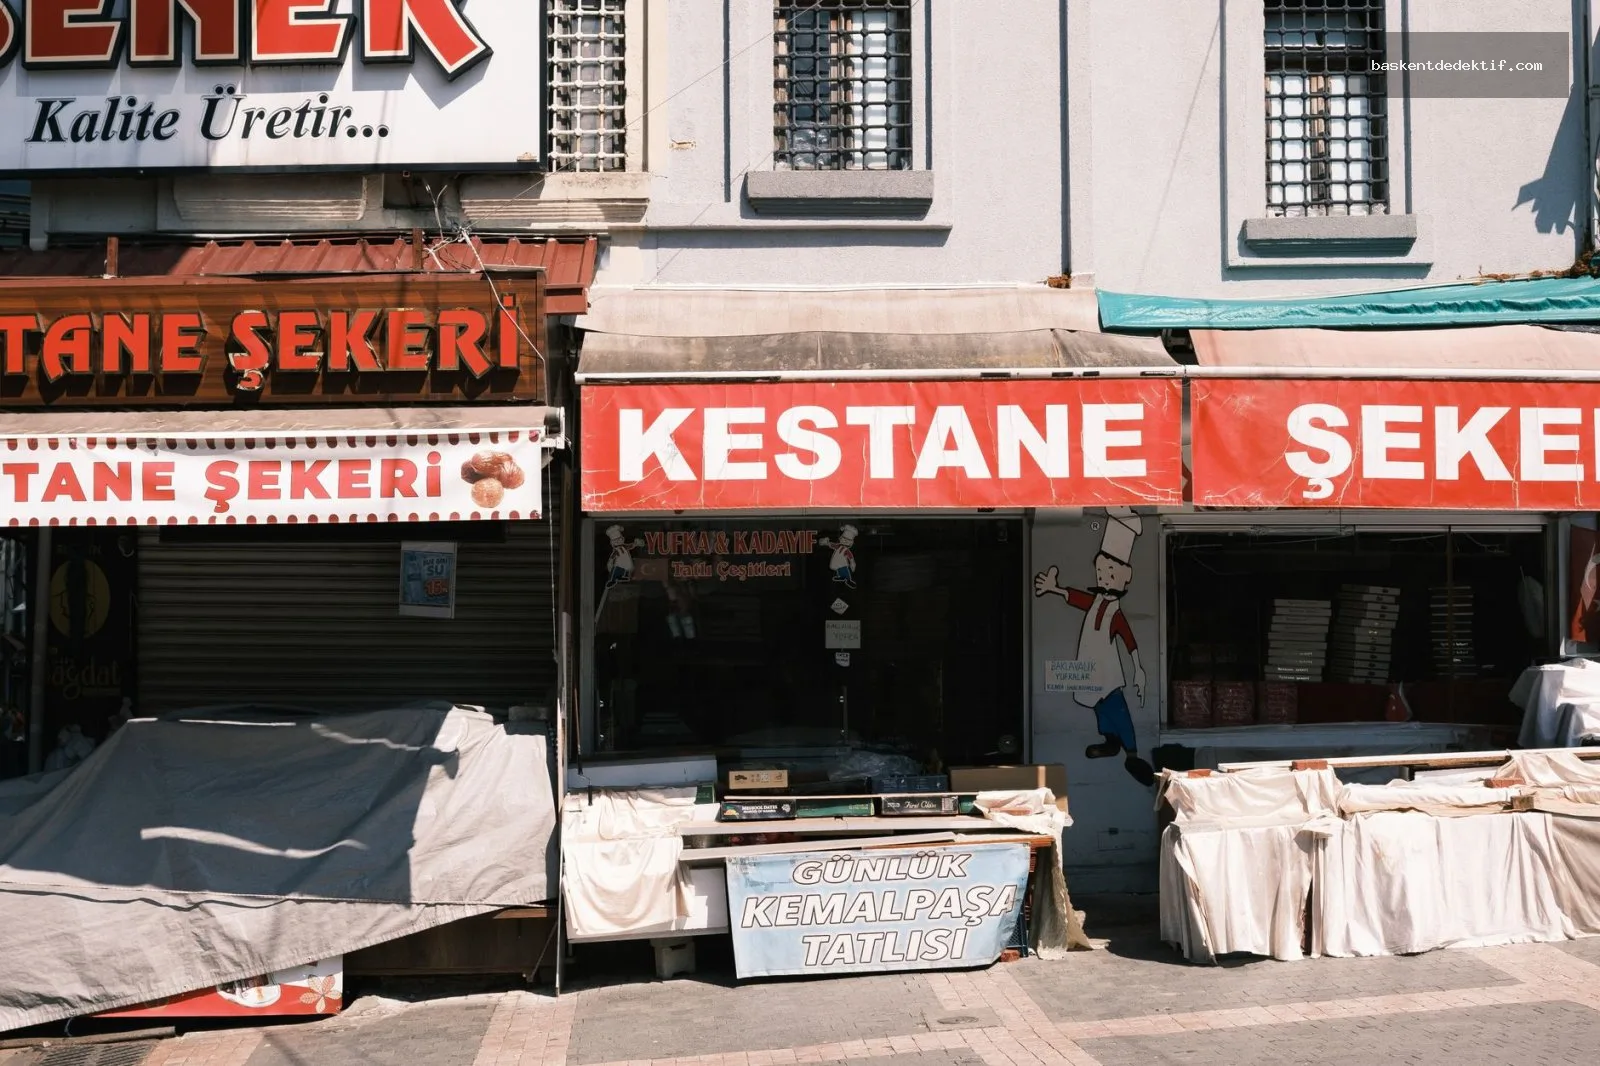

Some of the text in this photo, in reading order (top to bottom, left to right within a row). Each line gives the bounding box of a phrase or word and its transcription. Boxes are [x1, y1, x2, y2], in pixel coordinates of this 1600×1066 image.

[24, 83, 391, 144] Kalite Üretir...
[227, 292, 522, 392] ŞEKERİ
[618, 403, 1148, 483] KESTANE
[1284, 403, 1600, 501] ŞEKE
[2, 449, 443, 514] TANE ŞEKERİ
[644, 530, 819, 555] YUFKA & KADAYIF
[672, 560, 792, 582] Tatlı Çeşitleri
[792, 850, 972, 885] GÜNLÜK
[741, 884, 1018, 928] KEMALPAŞA
[802, 927, 968, 967] TATLISI
